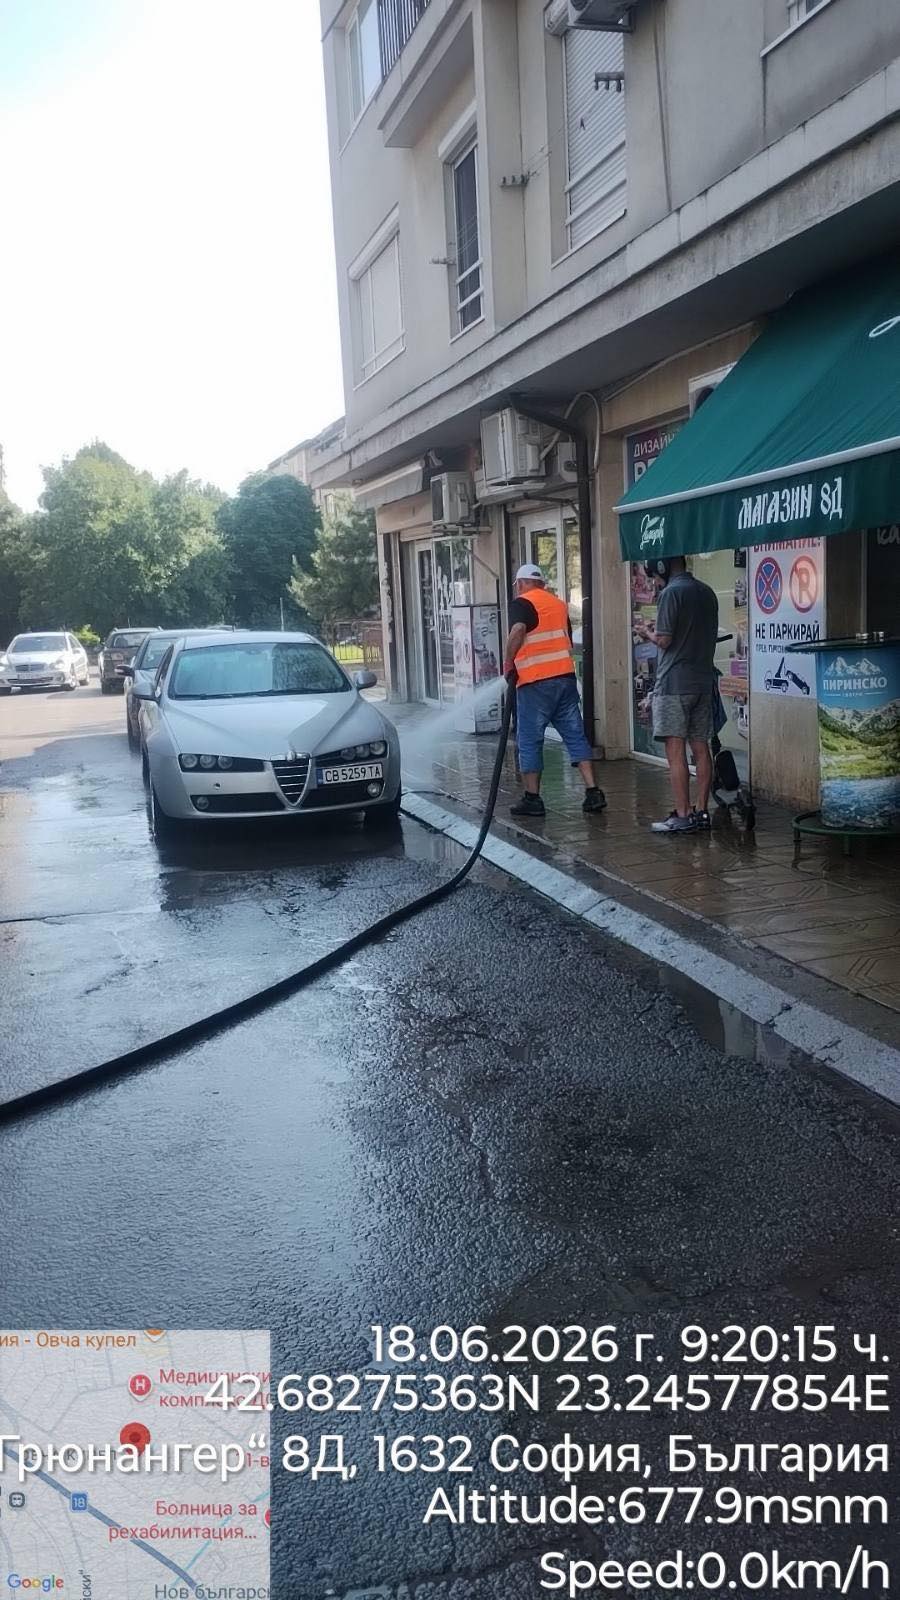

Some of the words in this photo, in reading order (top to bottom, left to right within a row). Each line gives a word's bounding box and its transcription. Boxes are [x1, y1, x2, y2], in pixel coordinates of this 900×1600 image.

[738, 484, 813, 529] МАГАЗИН
[820, 476, 843, 521] 8Д
[755, 623, 766, 640] НЕ
[769, 620, 820, 641] ПАРКИРАЙ
[823, 676, 888, 691] ПИРИНСКО
[341, 767, 367, 781] 5259
